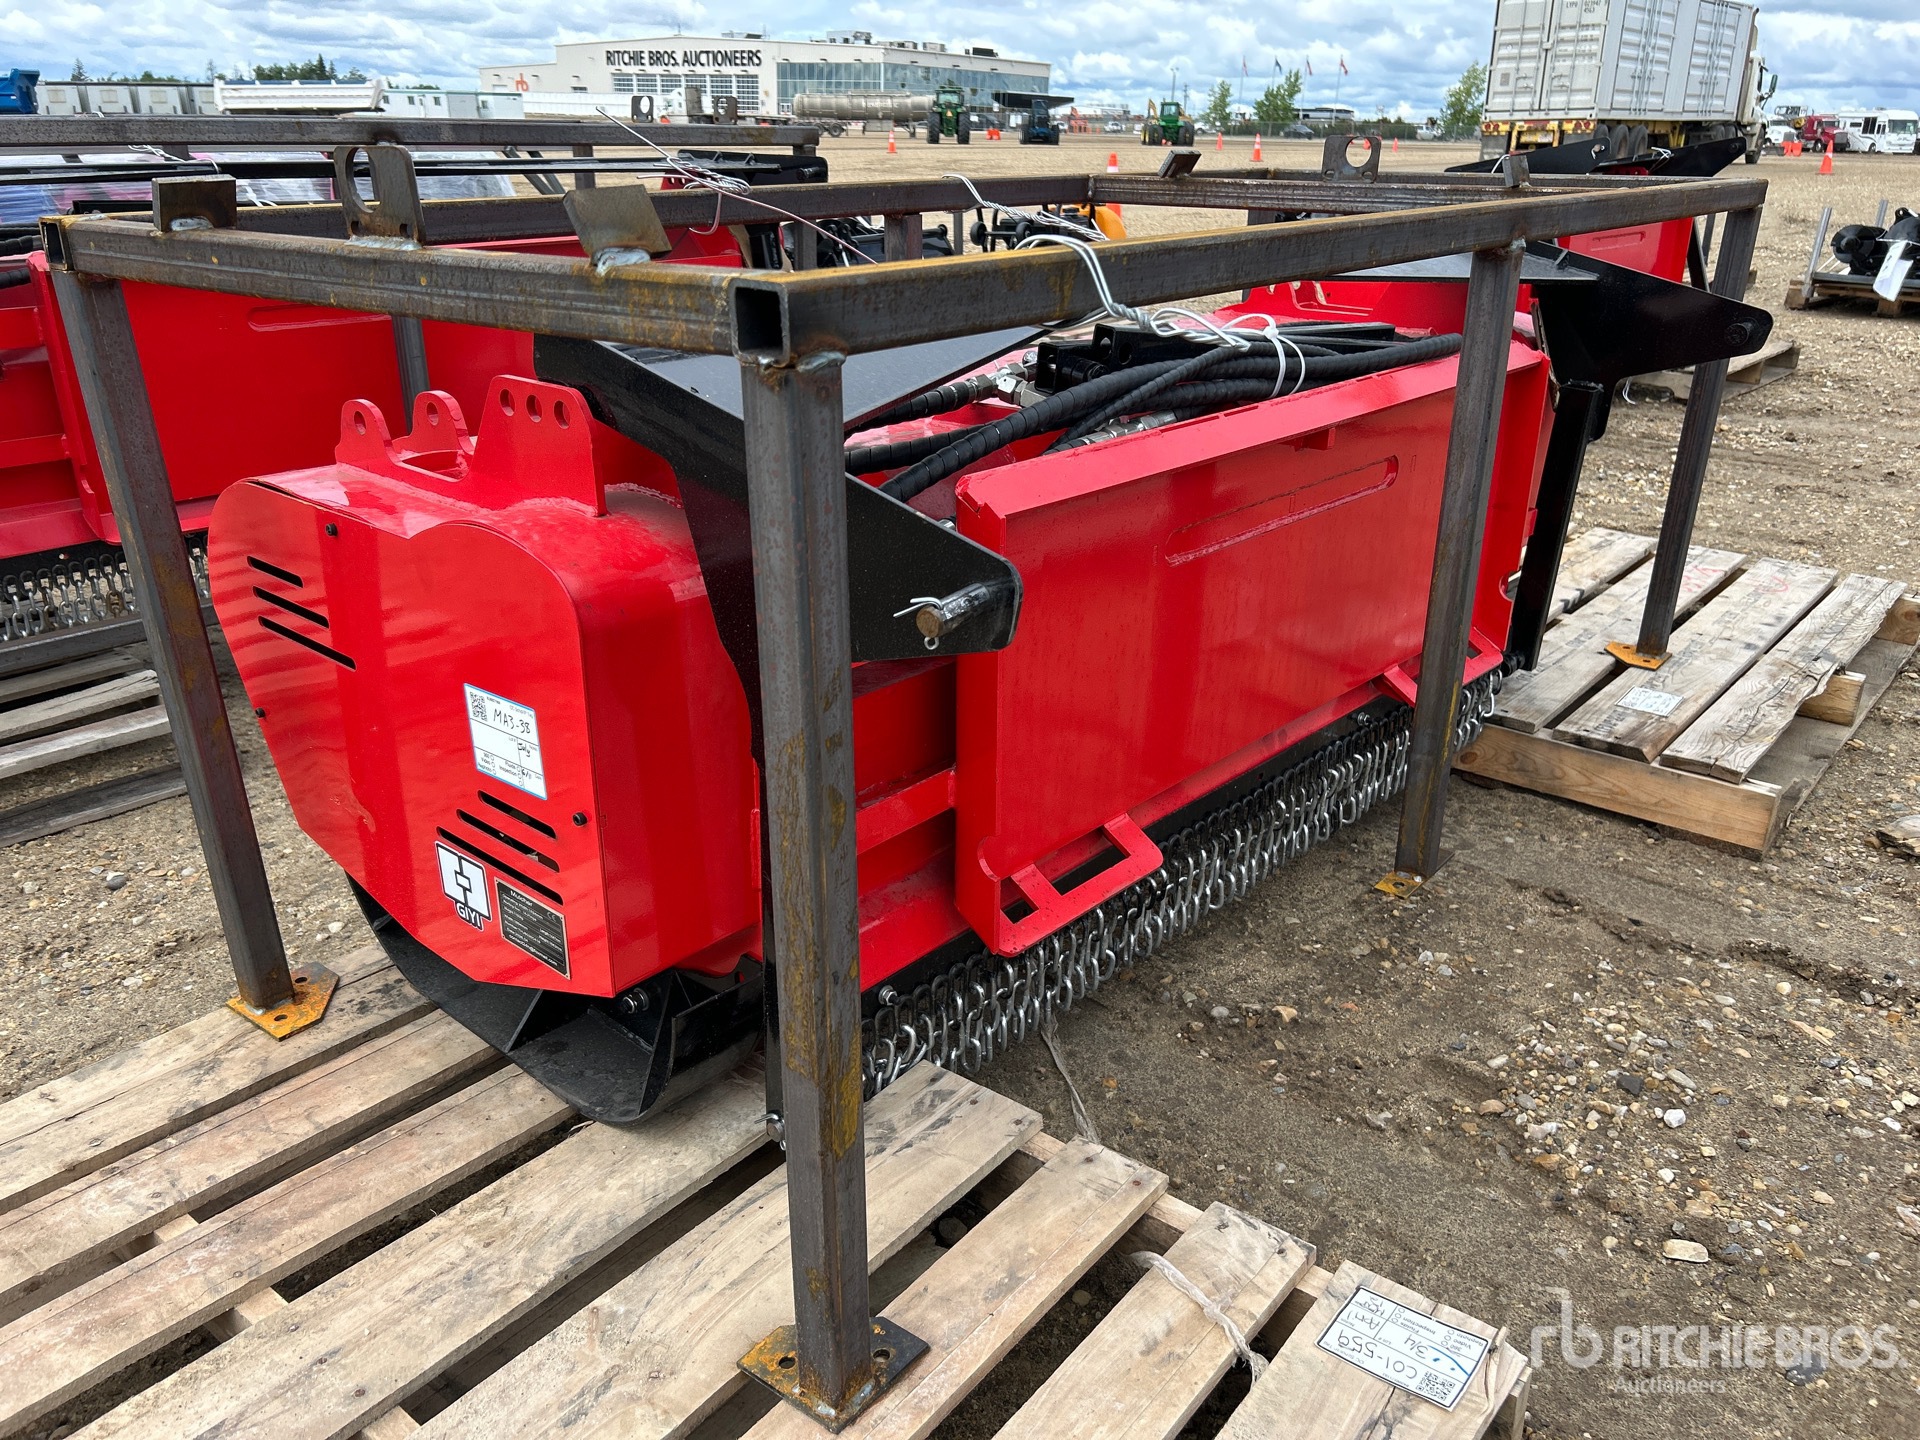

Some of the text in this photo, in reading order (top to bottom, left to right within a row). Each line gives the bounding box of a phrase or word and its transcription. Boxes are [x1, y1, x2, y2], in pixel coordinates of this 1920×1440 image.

[606, 50, 762, 67] RITCHIE BROS. AUCTIONEERS
[493, 708, 531, 734] MA3-38
[456, 902, 481, 927] GIYI
[1401, 1316, 1436, 1334] Inspection
[1403, 1334, 1429, 1359] 3/4
[1452, 1338, 1472, 1349] Video
